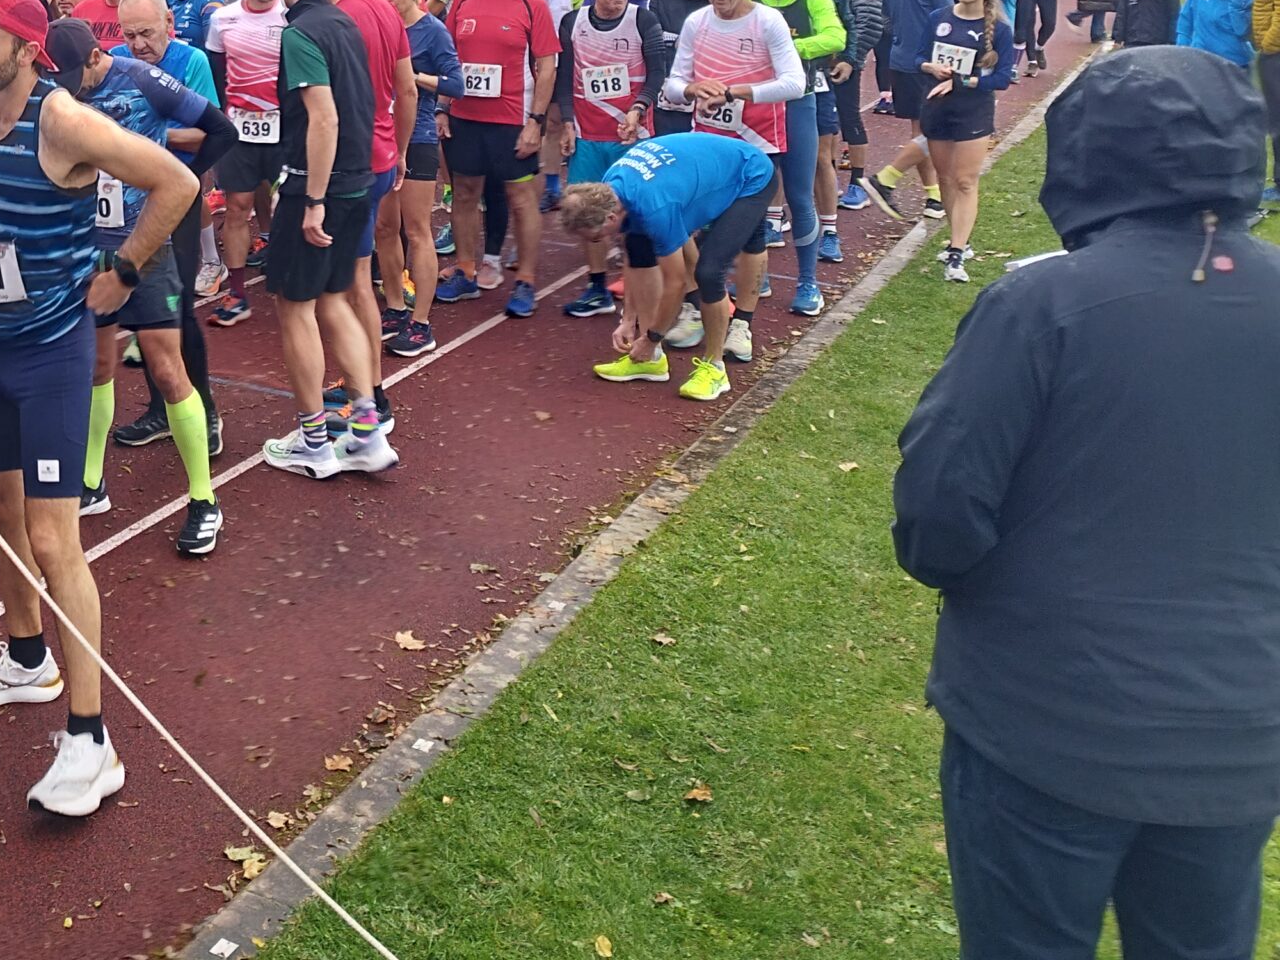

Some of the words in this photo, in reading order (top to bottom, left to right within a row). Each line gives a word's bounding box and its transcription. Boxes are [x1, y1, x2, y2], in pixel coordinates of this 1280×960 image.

[937, 54, 963, 71] 531
[466, 75, 490, 91] 621
[591, 77, 622, 94] 618
[242, 121, 270, 137] 639
